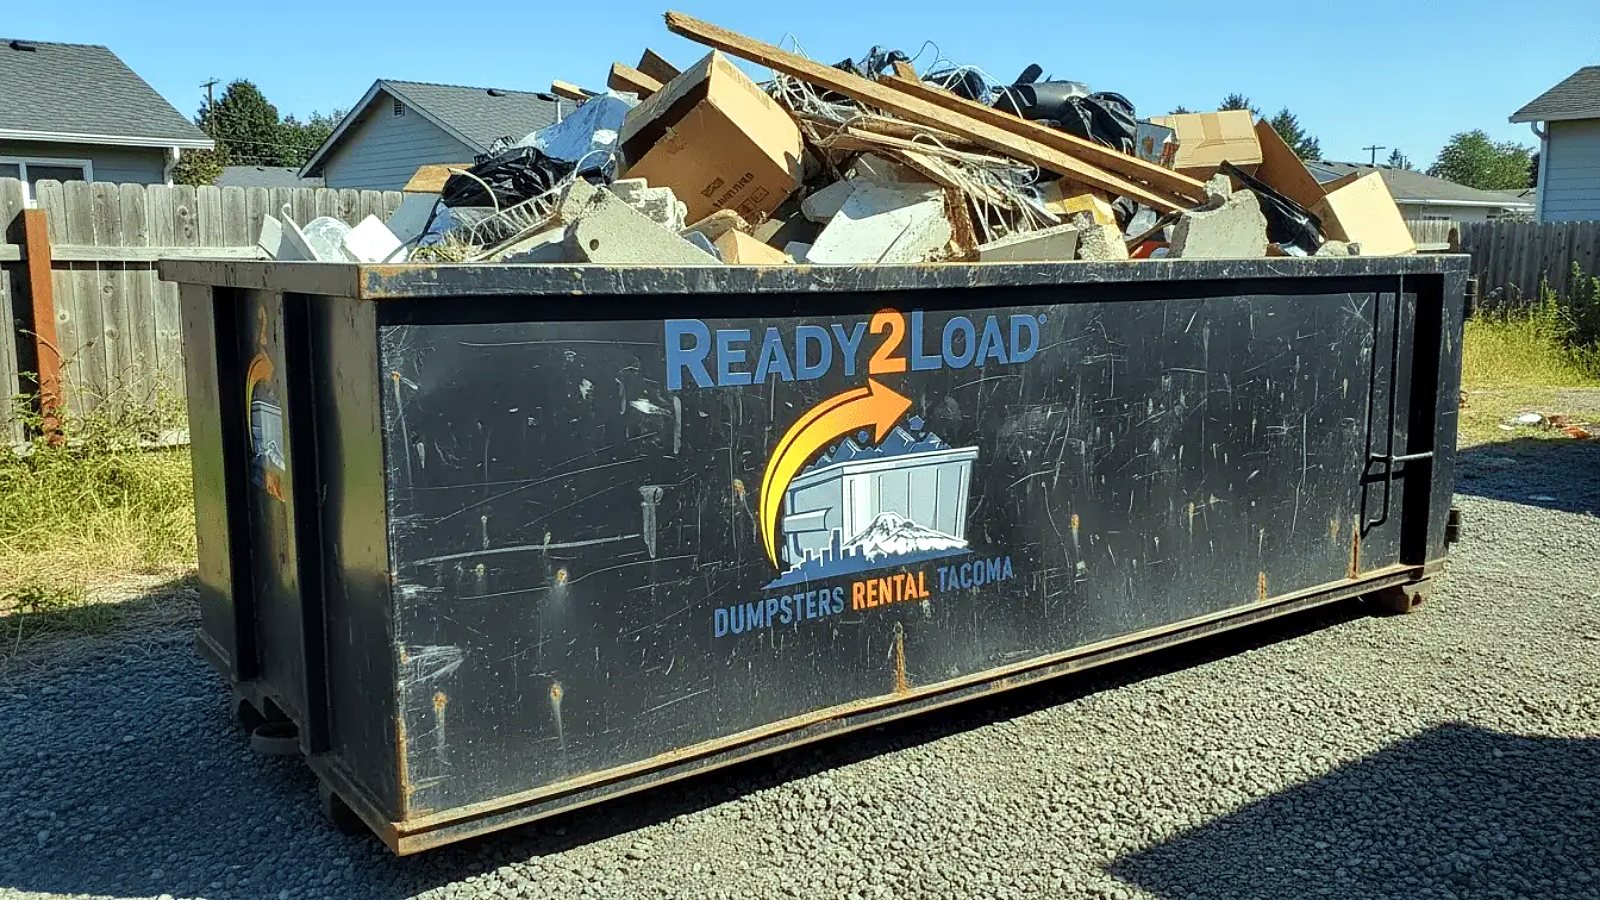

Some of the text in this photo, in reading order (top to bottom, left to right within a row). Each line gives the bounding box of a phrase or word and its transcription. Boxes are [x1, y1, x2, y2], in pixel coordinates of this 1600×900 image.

[714, 555, 1015, 638] DUMPSTERS RENTAL TACOMA
